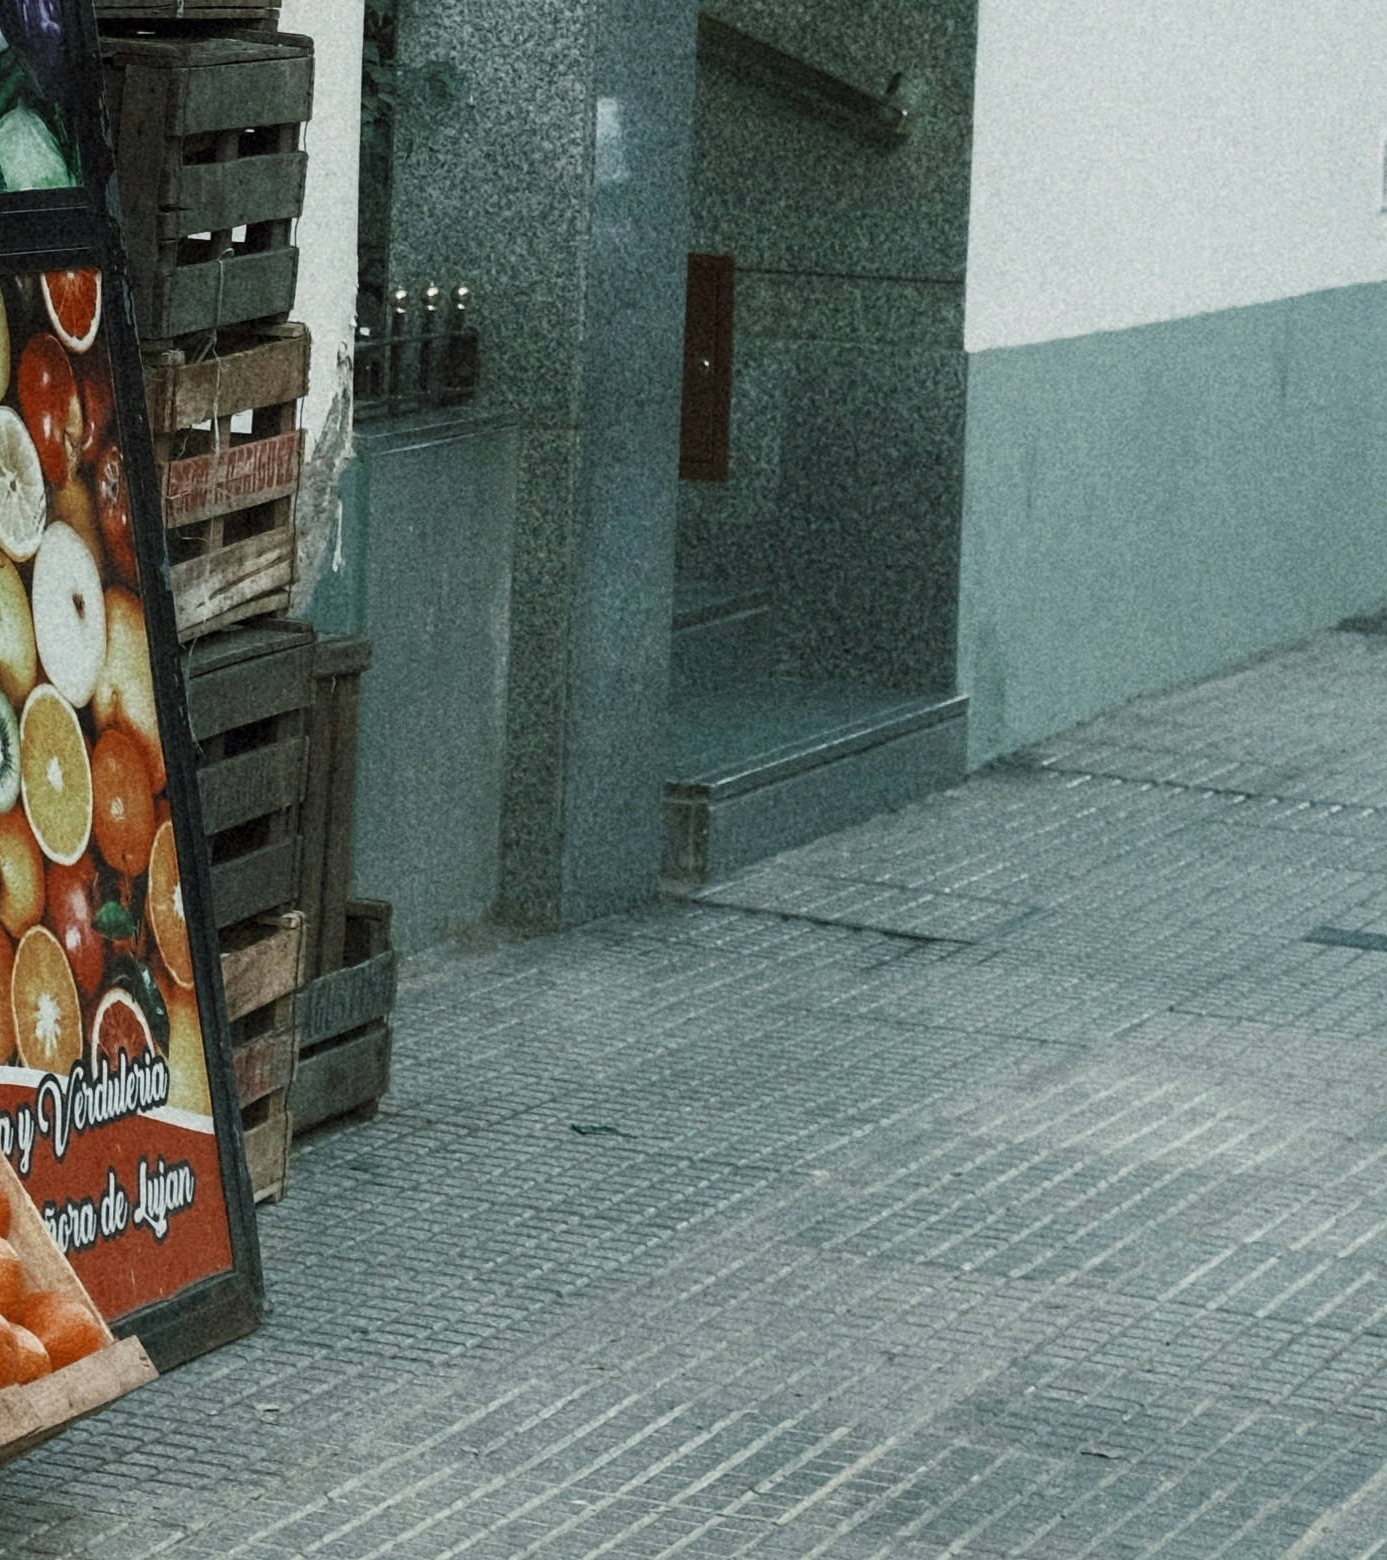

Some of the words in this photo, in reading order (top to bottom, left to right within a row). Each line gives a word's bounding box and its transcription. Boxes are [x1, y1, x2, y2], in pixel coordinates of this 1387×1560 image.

[17, 1106, 35, 1174] y
[37, 1052, 167, 1159] Verduleria
[100, 1170, 129, 1237] de
[133, 1160, 195, 1240] Lujan
